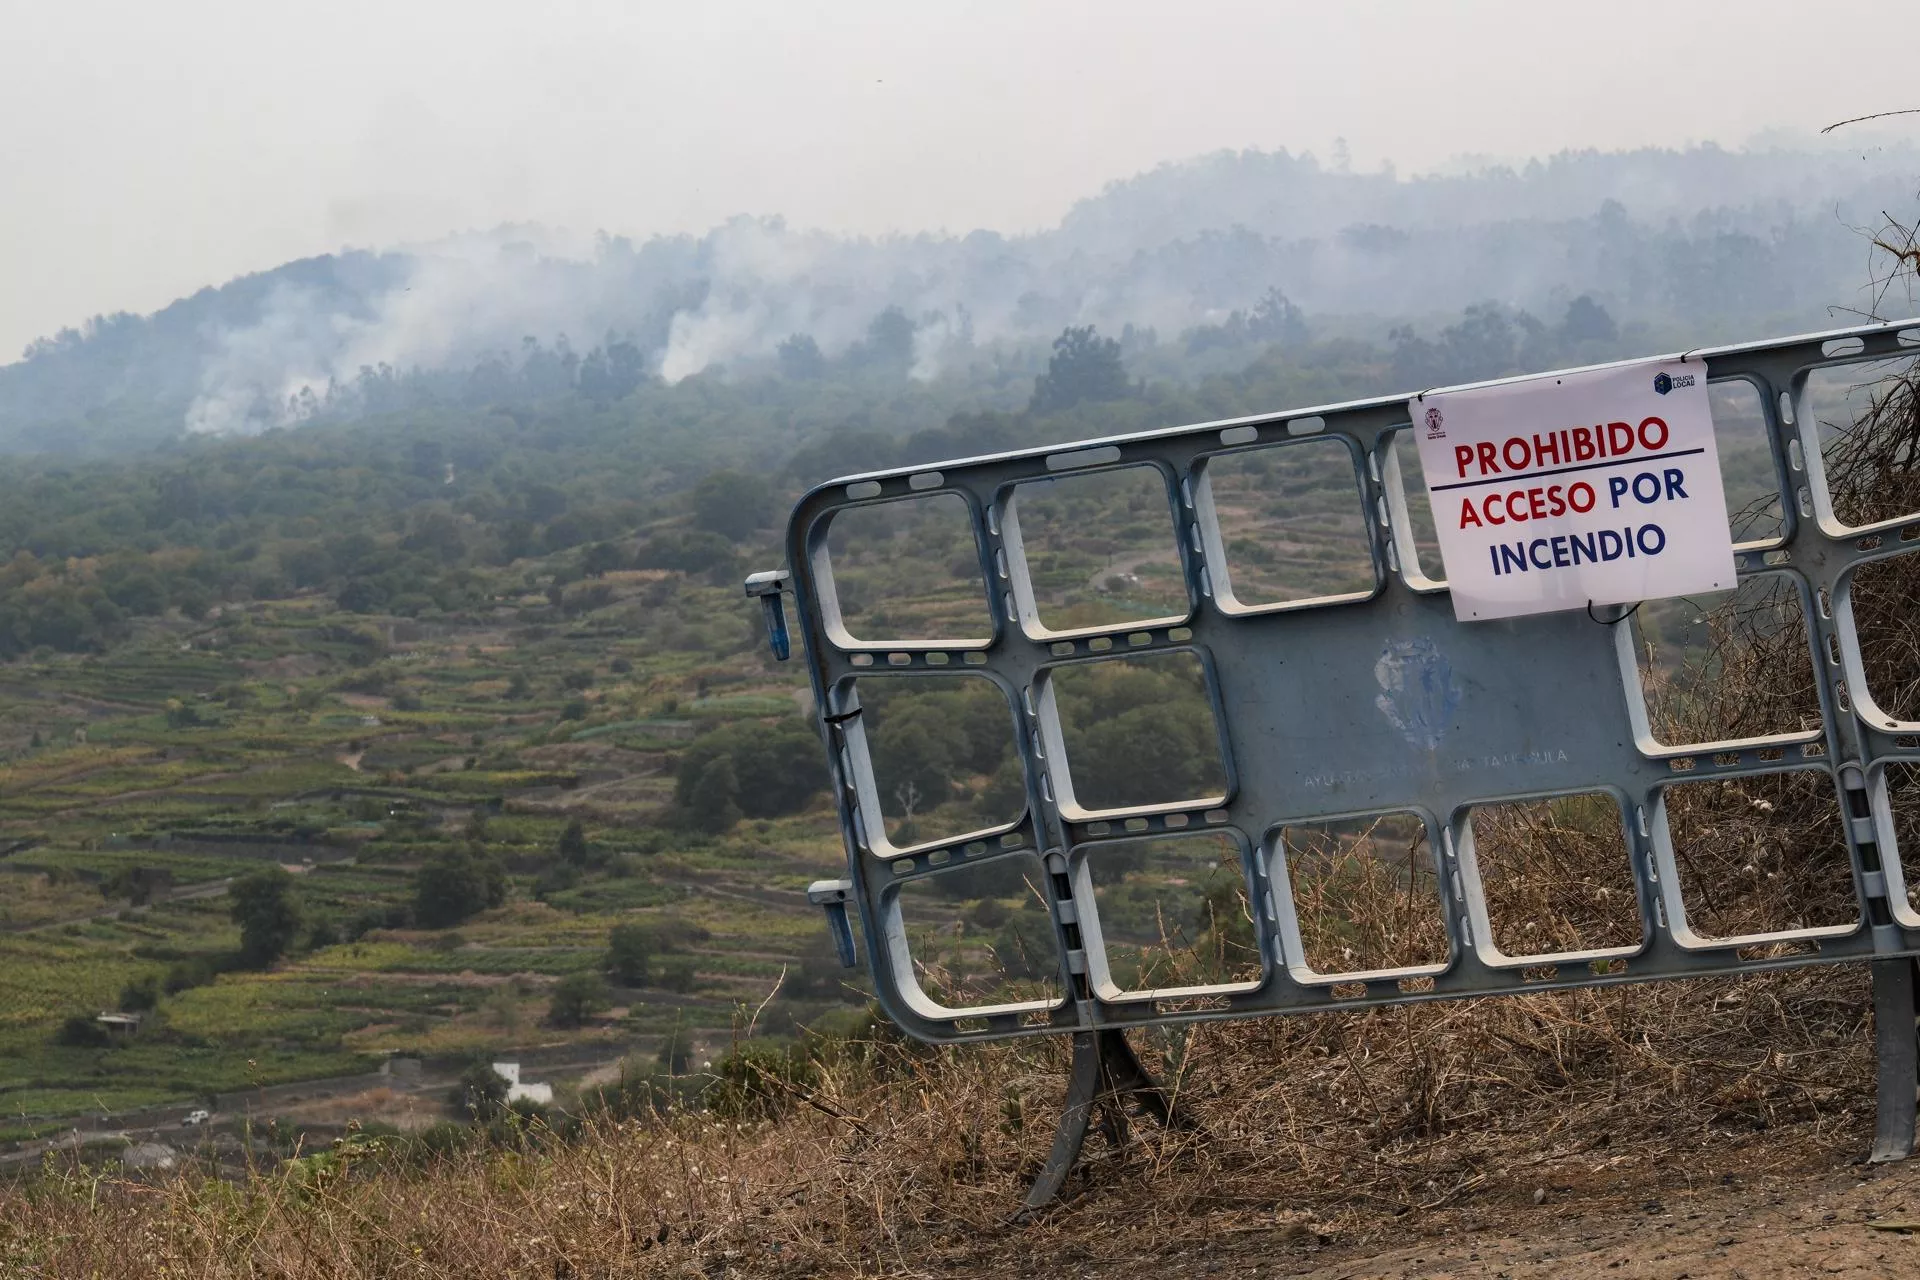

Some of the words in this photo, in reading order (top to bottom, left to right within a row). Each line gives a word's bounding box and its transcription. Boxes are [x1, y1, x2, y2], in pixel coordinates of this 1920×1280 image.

[1672, 380, 1695, 389] LOCAL
[1455, 416, 1669, 478] PROHIBIDO
[1459, 482, 1595, 529] ACCESO
[1609, 468, 1689, 508] POR
[1490, 523, 1666, 576] INCENDIO
